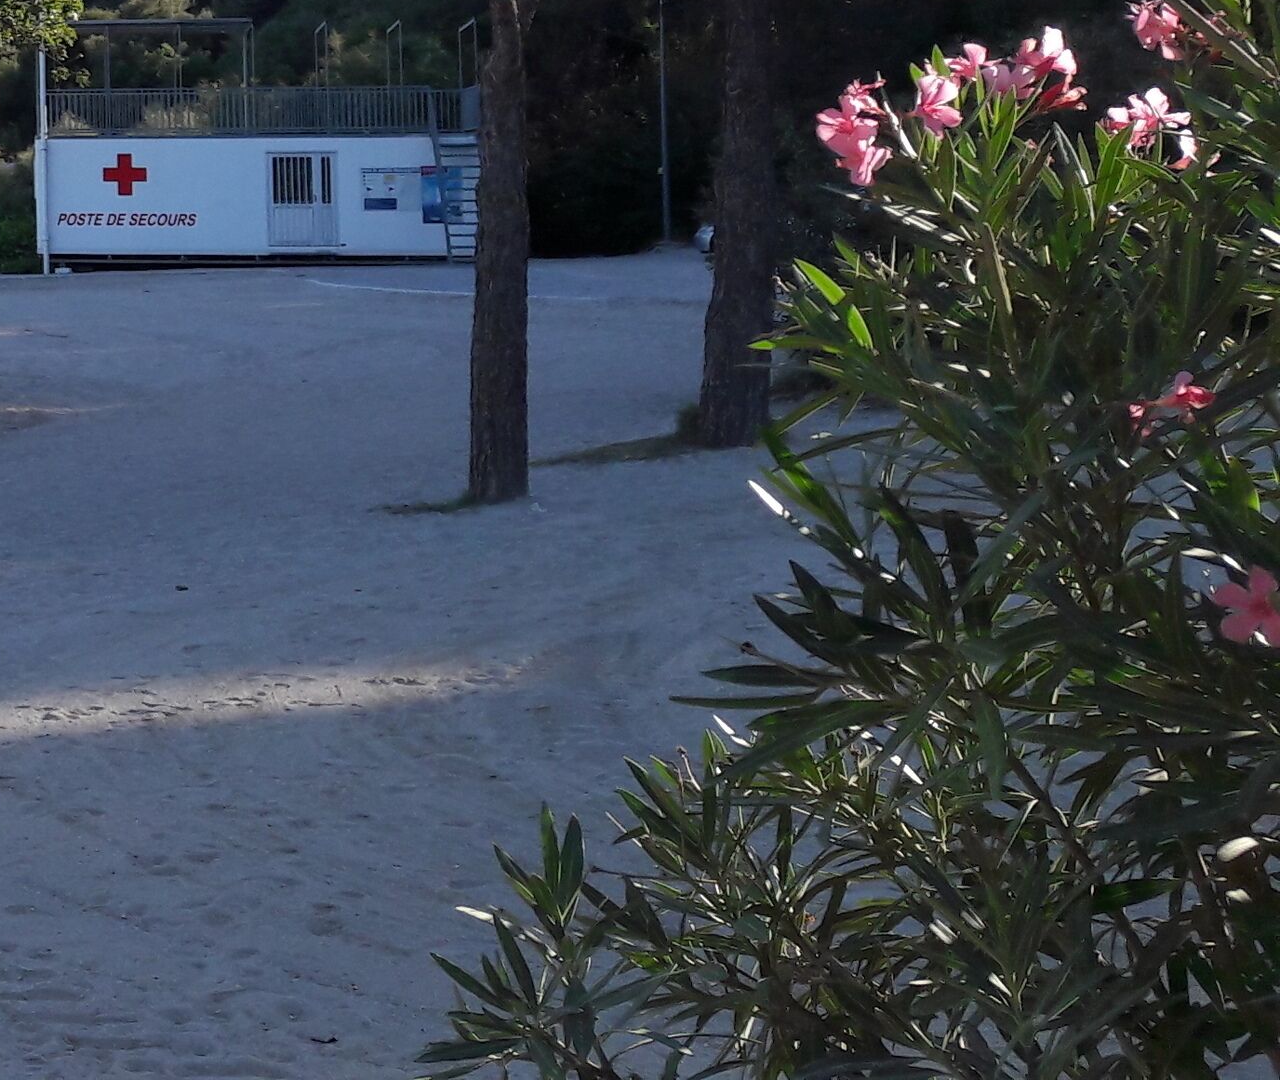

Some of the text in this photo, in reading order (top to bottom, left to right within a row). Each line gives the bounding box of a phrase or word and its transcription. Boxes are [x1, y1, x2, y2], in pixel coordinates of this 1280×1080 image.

[57, 213, 197, 226] POSTE DE SECOURS
